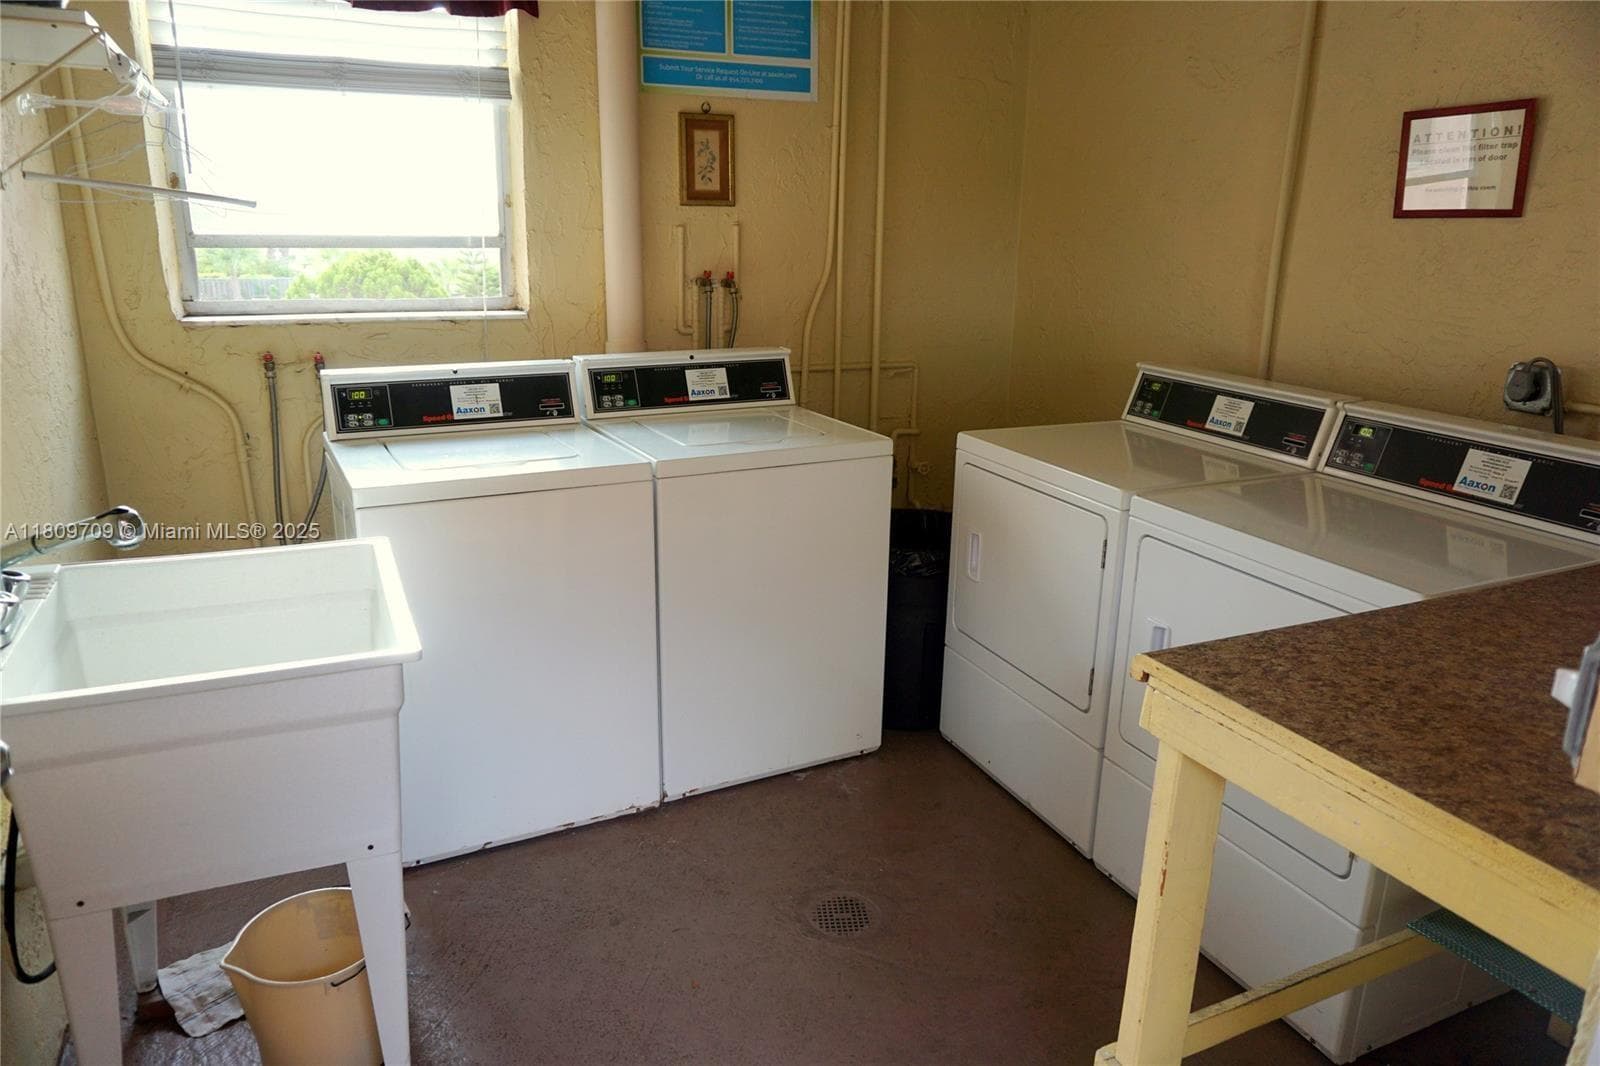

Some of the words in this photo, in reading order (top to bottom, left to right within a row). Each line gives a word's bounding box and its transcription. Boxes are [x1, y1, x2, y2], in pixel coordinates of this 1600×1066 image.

[1413, 125, 1522, 143] ATTENTION!
[1478, 143, 1499, 151] filter
[1501, 142, 1518, 150] trap
[1478, 154, 1487, 162] of
[1488, 153, 1508, 161] door
[604, 374, 616, 382] 100
[351, 391, 365, 400] 100
[691, 388, 716, 396] Aaxon
[456, 406, 486, 414] Aaxon
[1209, 416, 1232, 428] Aaxon
[1459, 476, 1497, 493] Aaxon
